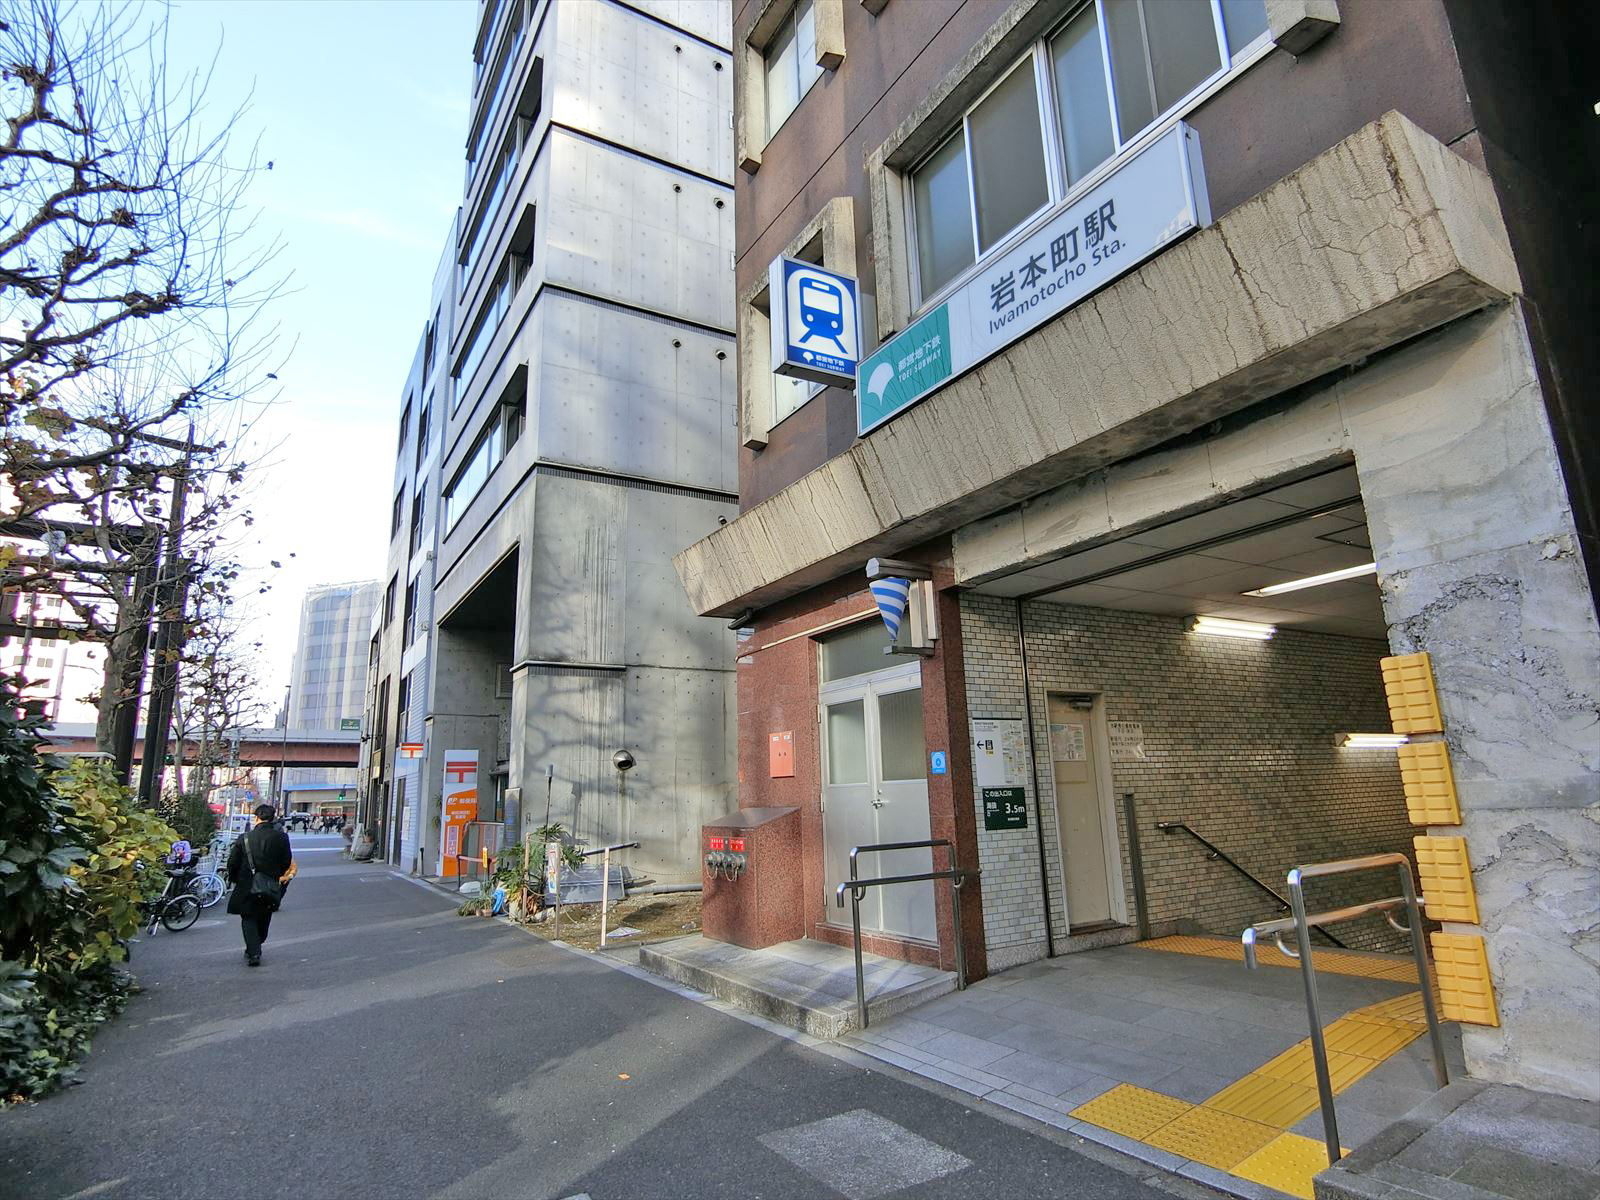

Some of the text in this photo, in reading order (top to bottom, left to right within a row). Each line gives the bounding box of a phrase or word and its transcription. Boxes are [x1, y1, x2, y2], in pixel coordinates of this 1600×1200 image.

[990, 199, 1118, 312] 岩本町駅
[989, 238, 1126, 334] Iwamotocho Sta.
[898, 335, 941, 372] 都営地下鉄
[898, 349, 941, 383] TOEI SUBWAY
[1005, 802, 1025, 814] 3.5m
